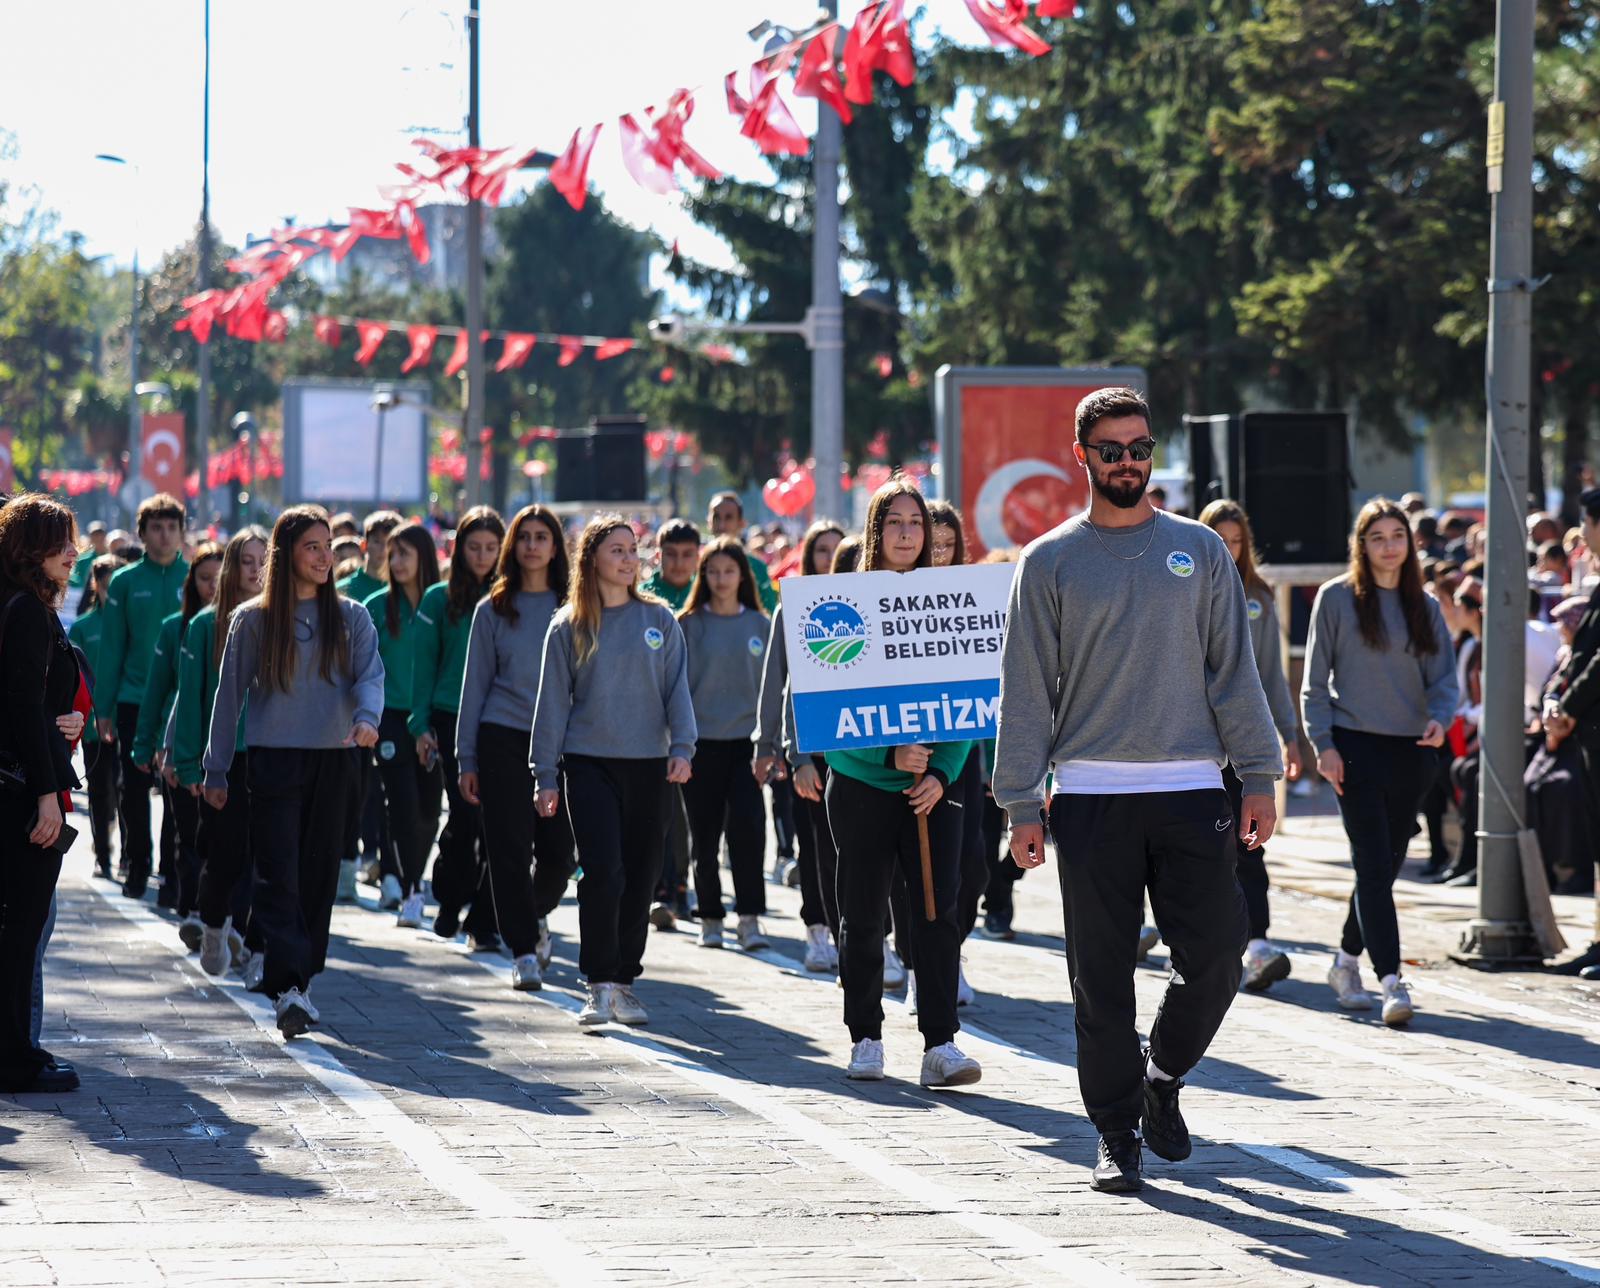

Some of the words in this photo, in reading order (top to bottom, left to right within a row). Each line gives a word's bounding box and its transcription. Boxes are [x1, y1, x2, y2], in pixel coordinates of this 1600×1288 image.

[805, 595, 858, 612] SAKARYA
[879, 592, 977, 613] SAKARYA
[836, 693, 1000, 740] ATLETİZM
